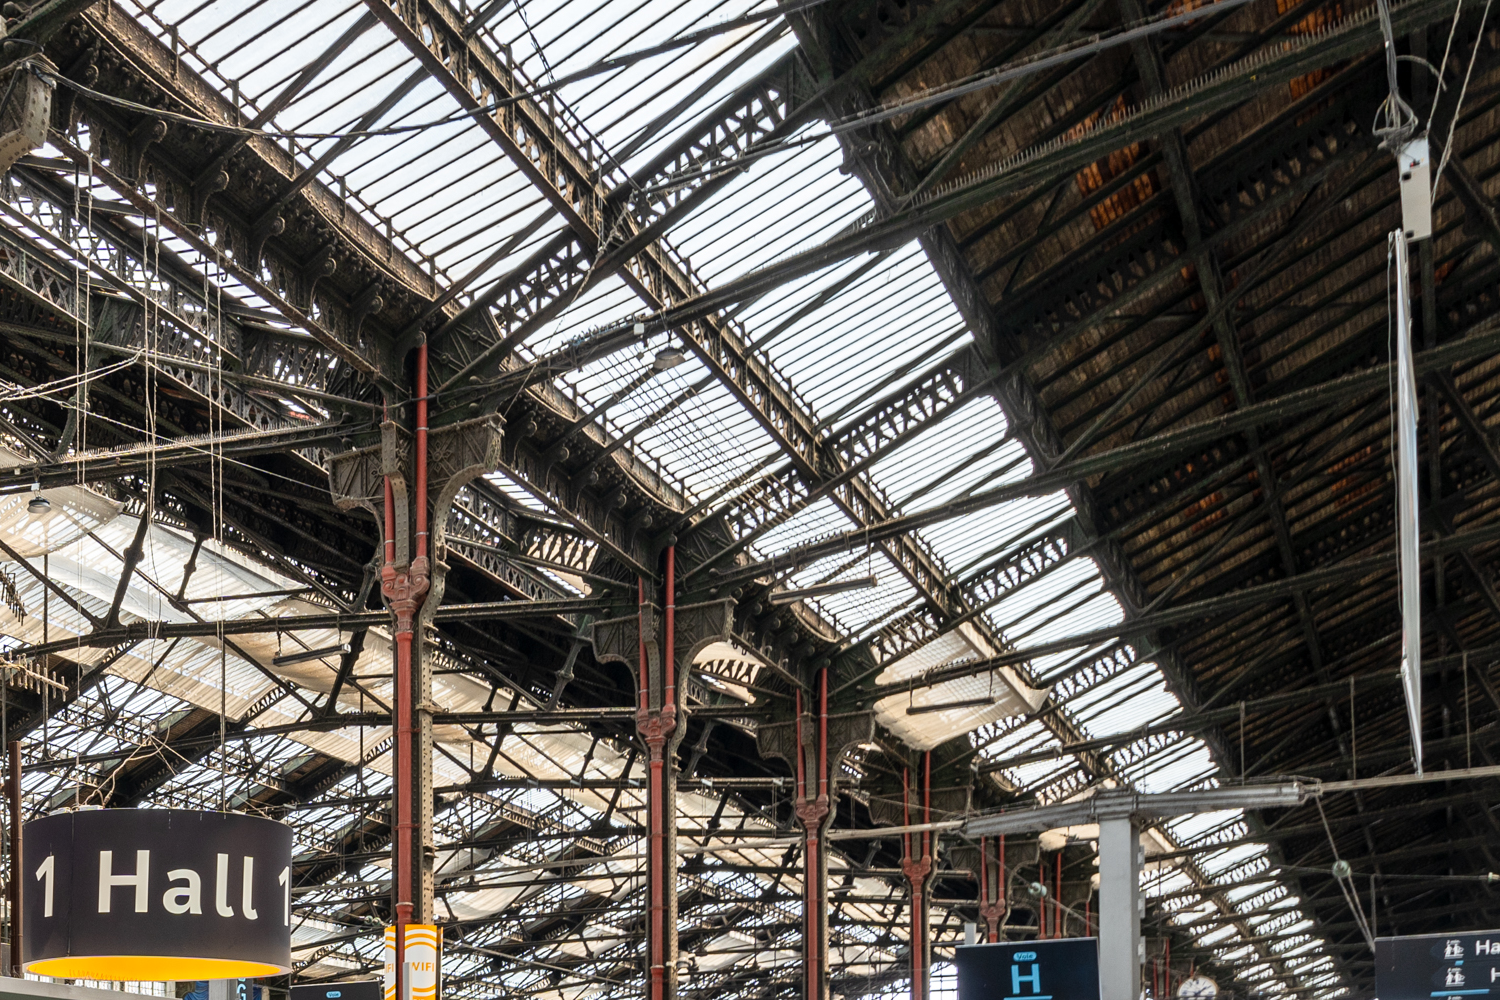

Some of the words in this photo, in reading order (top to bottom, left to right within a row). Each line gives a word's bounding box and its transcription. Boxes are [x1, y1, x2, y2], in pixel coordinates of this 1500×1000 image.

[35, 856, 56, 917] 1
[98, 850, 259, 920] Hall
[278, 866, 291, 927] 1
[1010, 962, 1041, 995] H
